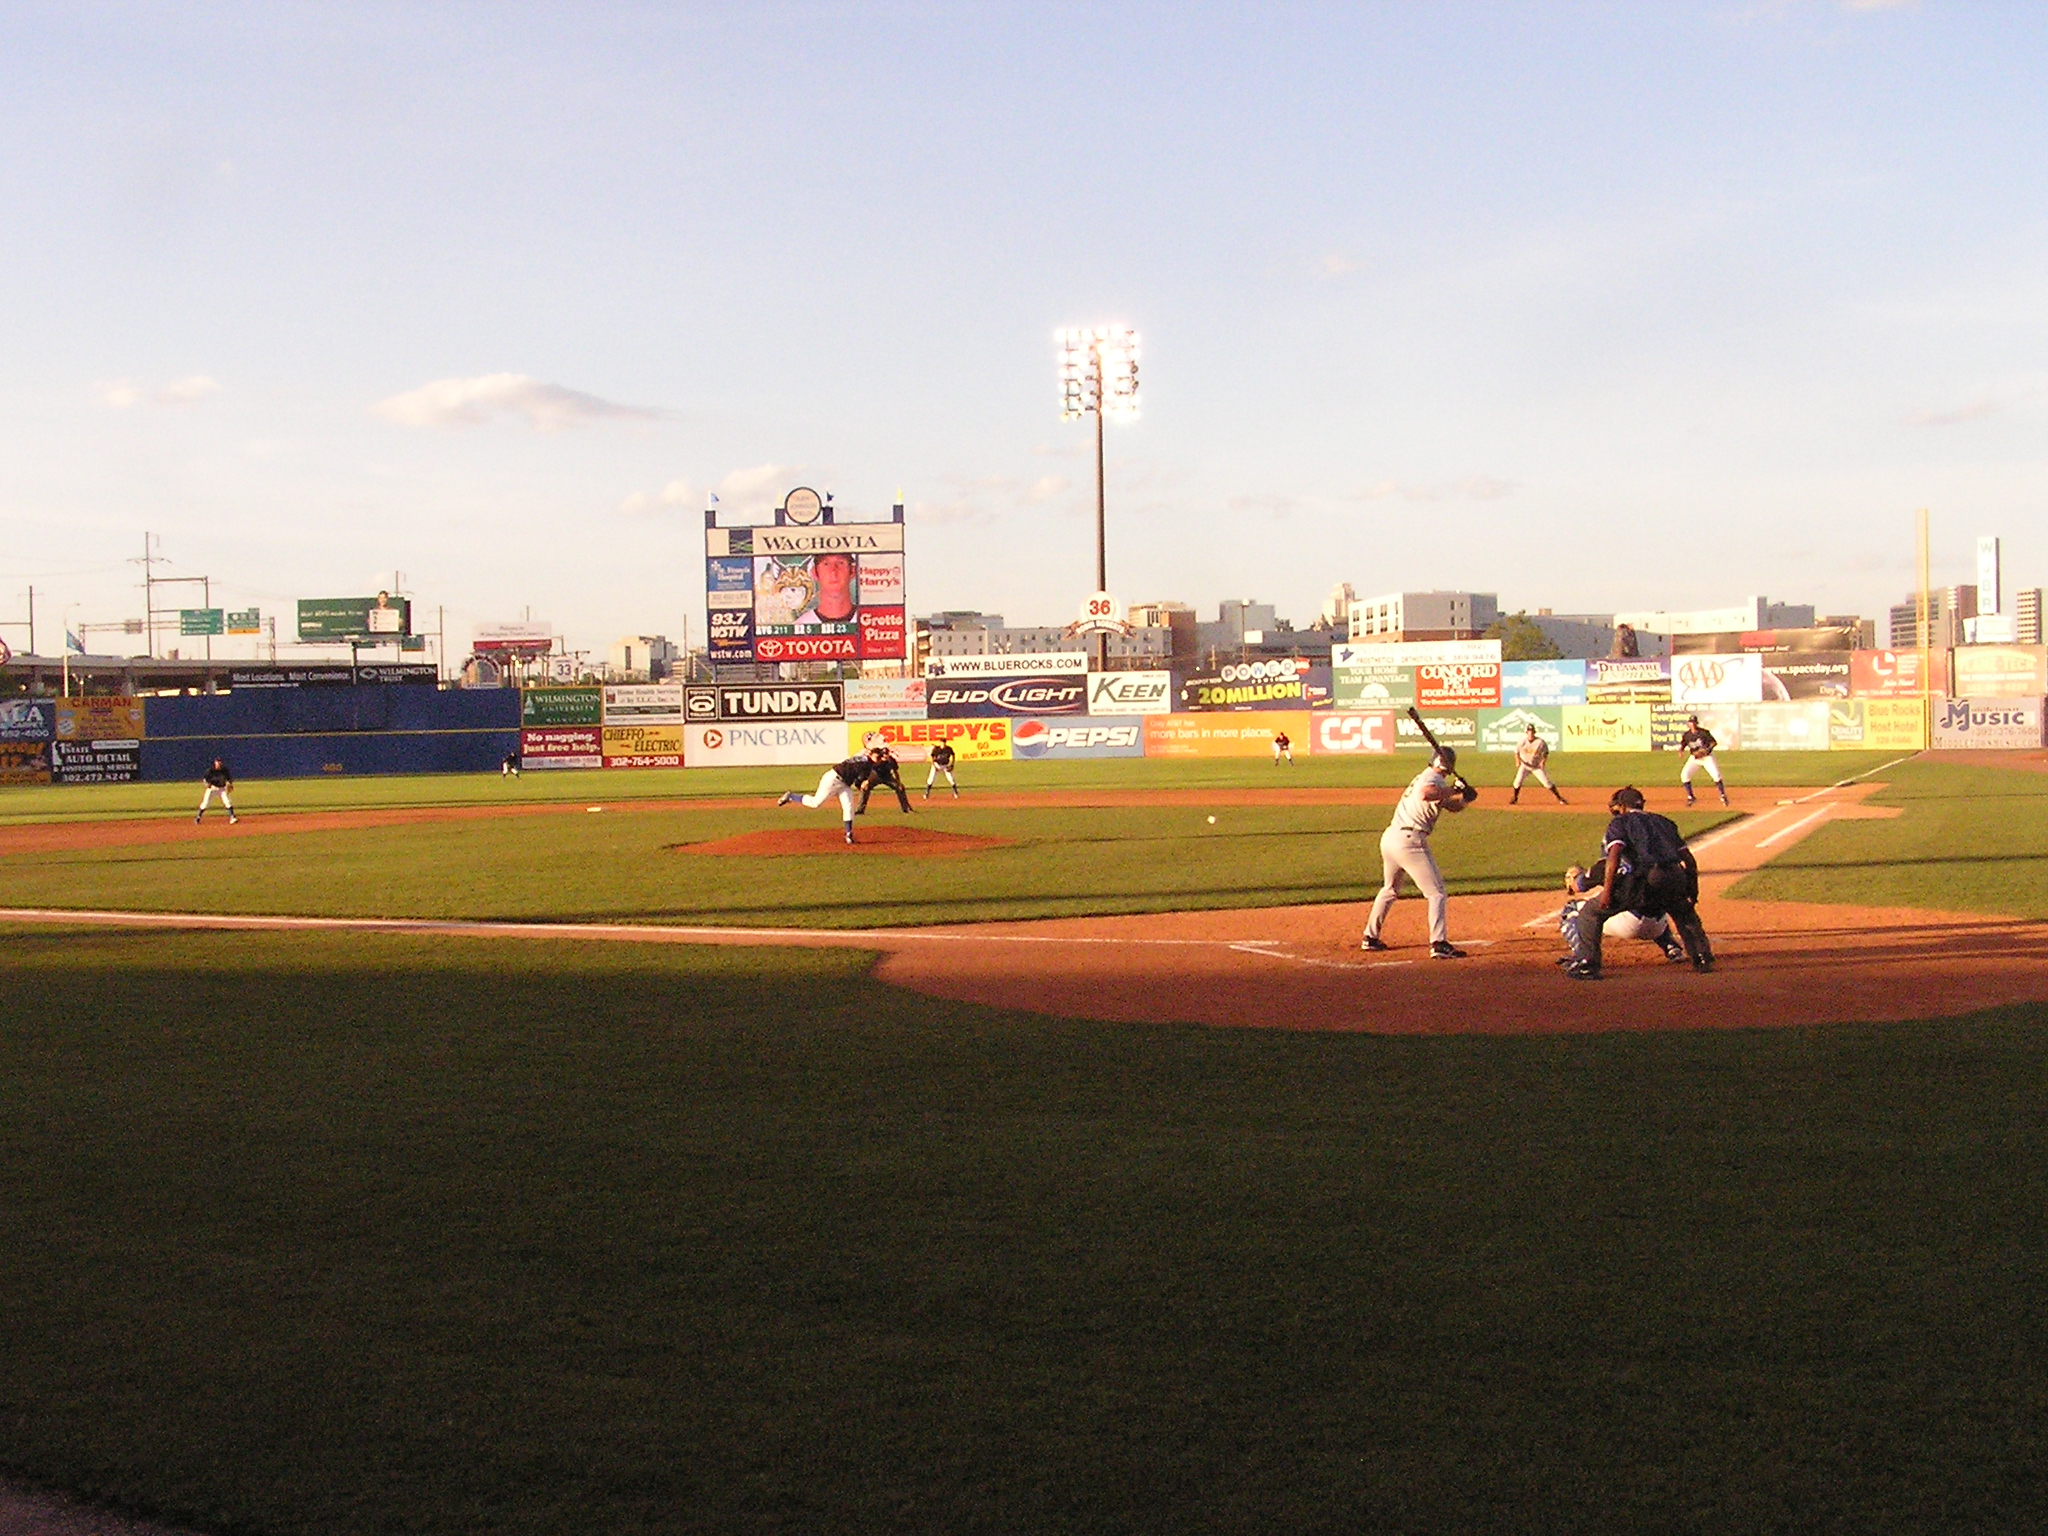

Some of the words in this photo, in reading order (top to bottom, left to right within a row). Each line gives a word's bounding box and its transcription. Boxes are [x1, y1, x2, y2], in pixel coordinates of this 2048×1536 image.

[762, 535, 878, 551] WACHOVIA
[860, 566, 892, 576] Happy
[860, 576, 901, 588] Harry's
[1089, 599, 1110, 615] 36
[712, 612, 747, 625] 93.7
[860, 613, 903, 626] Grotto
[711, 626, 748, 638] WSTW
[836, 624, 847, 633] 23
[865, 627, 899, 641] Pizza
[785, 639, 856, 655] TOYOTA
[710, 649, 752, 659] wstw.com
[557, 664, 572, 676] 33
[950, 658, 1083, 671] WWW.BLUEROCKS.COM
[1223, 661, 1294, 681] POWER
[1349, 667, 1373, 676] YOUR
[1374, 666, 1399, 675] HOME
[1599, 663, 1657, 672] DELAWARE
[378, 667, 437, 676] WILMINGTON
[1421, 665, 1498, 680] CONCORD
[1683, 659, 1721, 689] AAA
[1340, 676, 1362, 685] TEAM
[1363, 674, 1410, 684] ADVANTAGE
[1443, 677, 1471, 690] PET
[930, 690, 989, 704] BUD
[1002, 687, 1083, 702] LIGHT
[1092, 677, 1167, 704] KEEN
[535, 694, 600, 703] WILMINGTON
[724, 690, 838, 714] TUNDRA
[1869, 704, 1889, 716] Blue
[1893, 703, 1921, 716] Rocks
[1940, 698, 2025, 732] MUSIC
[879, 722, 1007, 743] SLEEPY'S
[1567, 724, 1617, 739] Melting
[1621, 724, 1643, 736] Pot
[1871, 720, 1891, 733] Host
[1894, 720, 1918, 732] Hotel
[527, 733, 543, 742] No
[545, 733, 596, 744] nagging.
[603, 728, 645, 740] CHIEFFO
[1046, 726, 1140, 748] PEPSI
[1150, 730, 1176, 739] more
[1178, 728, 1199, 739] bars
[1201, 728, 1211, 738] in
[1213, 729, 1238, 738] more
[1321, 717, 1383, 750] CSC
[524, 744, 546, 754] Just
[547, 743, 569, 752] free
[572, 742, 601, 753] help.
[634, 739, 680, 752] ELECTRIC
[66, 754, 93, 763] AUTO
[96, 752, 131, 763] DETAIL
